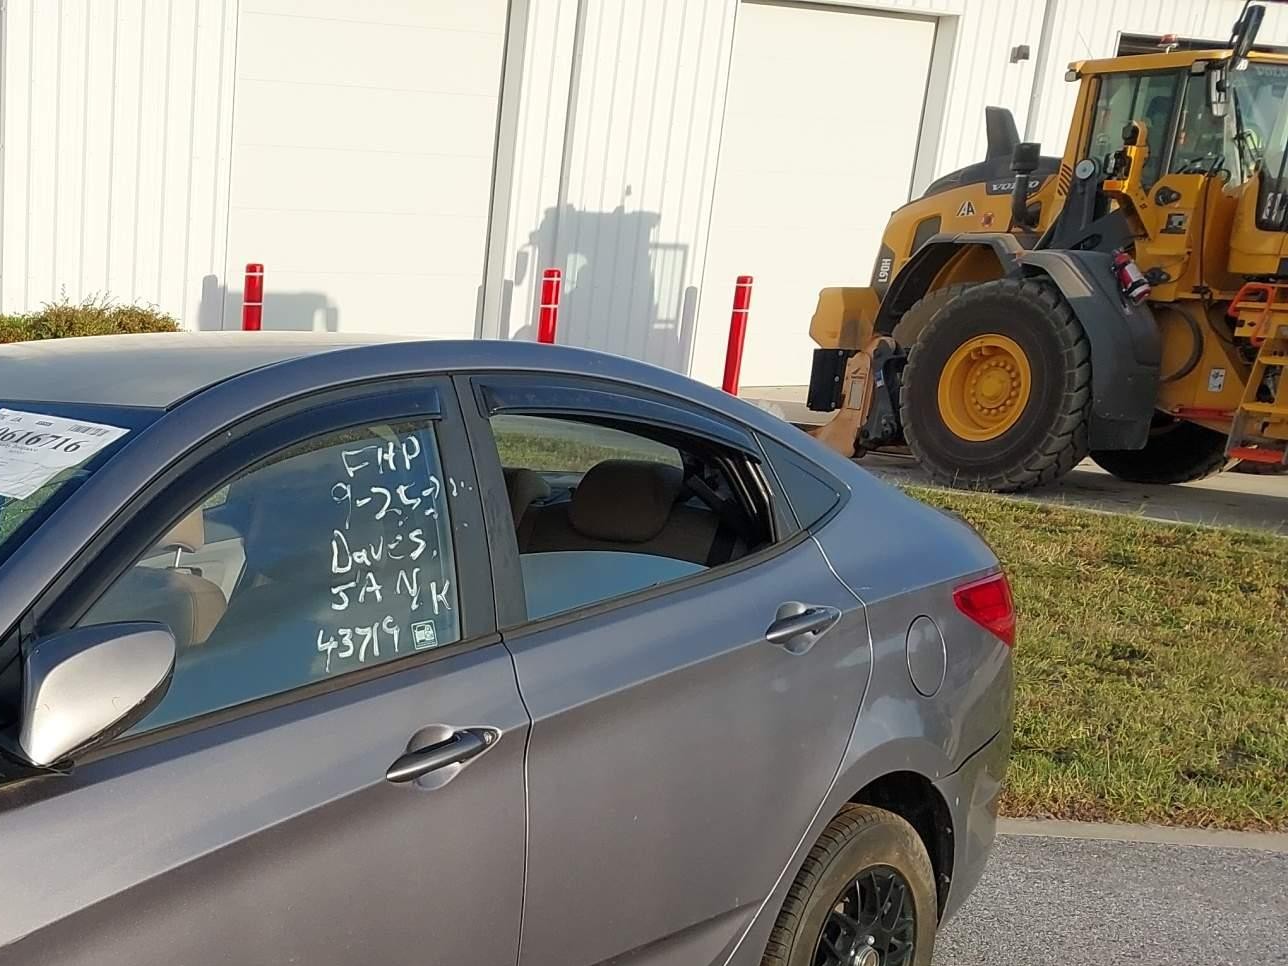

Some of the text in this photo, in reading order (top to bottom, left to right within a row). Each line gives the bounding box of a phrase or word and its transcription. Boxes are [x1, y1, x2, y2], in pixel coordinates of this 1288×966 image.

[878, 258, 892, 283] L90H
[341, 435, 421, 478] FHP
[317, 615, 401, 673] 43719
